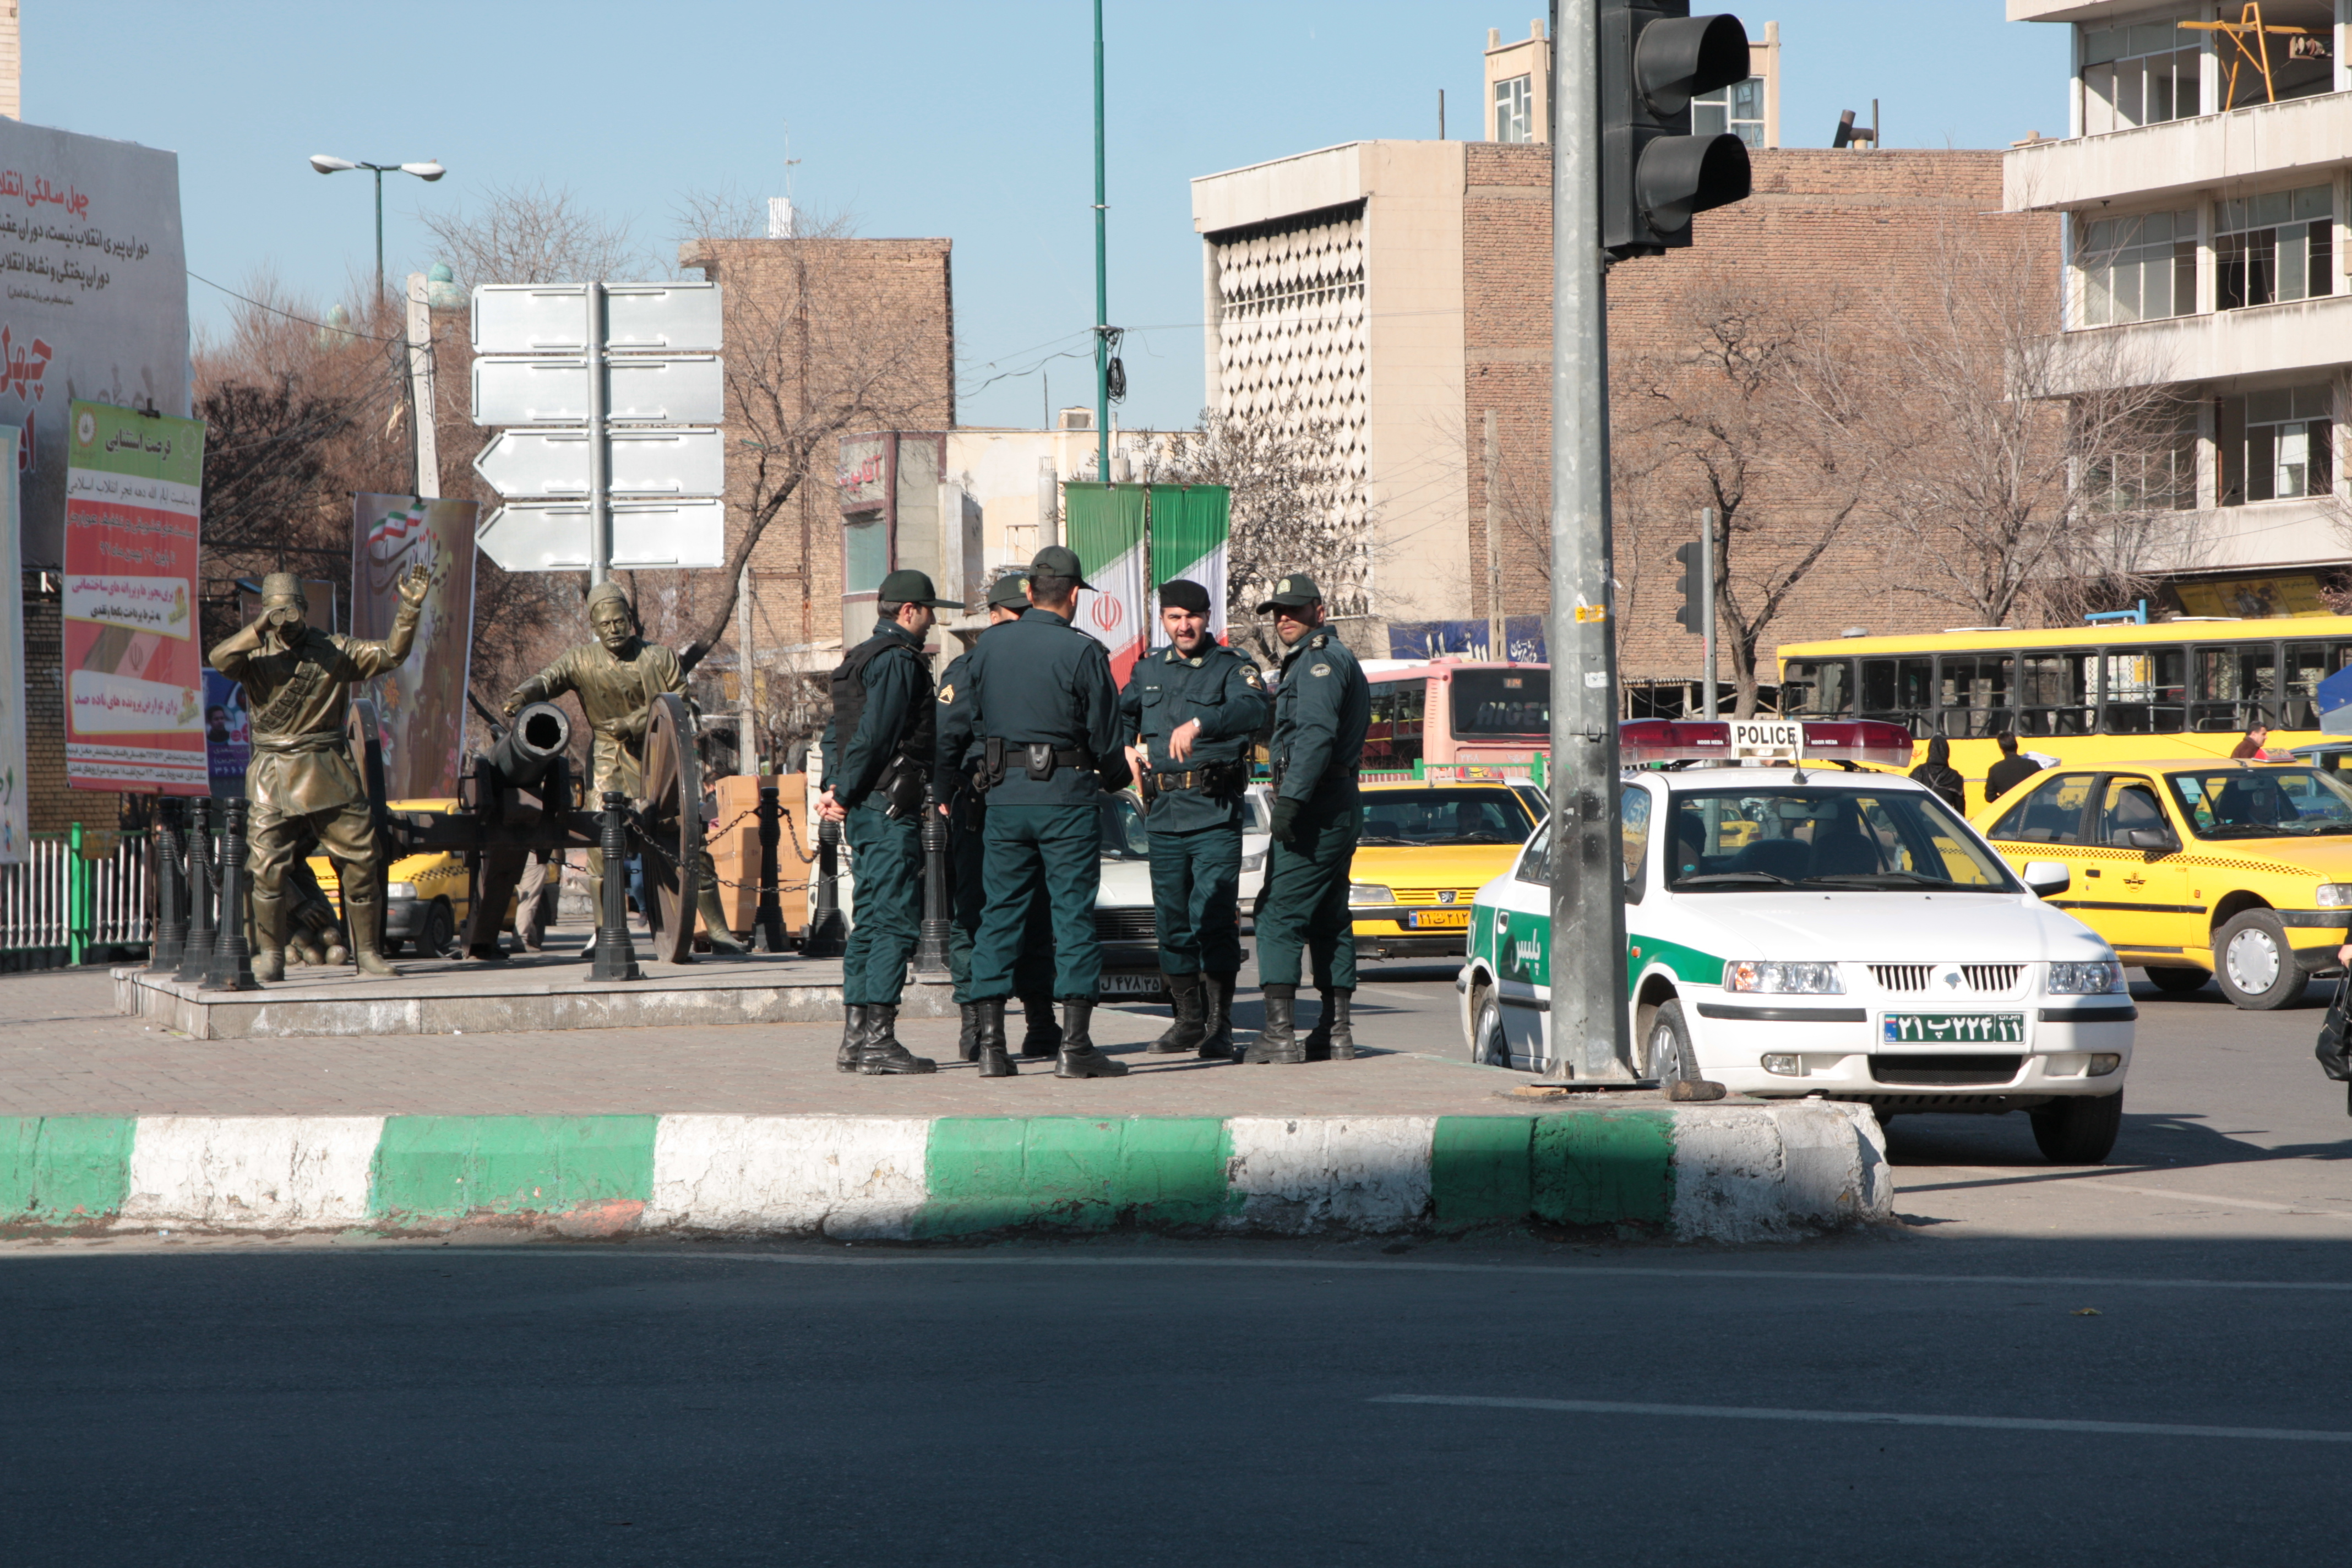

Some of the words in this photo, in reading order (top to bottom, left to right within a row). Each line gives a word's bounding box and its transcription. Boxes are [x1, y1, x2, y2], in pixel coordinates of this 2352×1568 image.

[0, 170, 23, 197] انقلا
[25, 174, 64, 207] سالگی
[66, 184, 89, 221] چهل
[18, 217, 43, 243] دوران
[75, 227, 103, 249] انقلاب
[104, 237, 126, 262] پیری
[126, 235, 149, 260] دوران
[26, 253, 49, 275] نشاط
[50, 266, 55, 282] و
[57, 259, 85, 291] پختگی
[86, 265, 110, 291] دوران
[106, 428, 143, 453] استثنایی
[145, 435, 171, 460] فرصت
[67, 476, 94, 494] اسلامی
[96, 479, 118, 494] انقلاب
[119, 483, 132, 499] فجر
[134, 488, 145, 498] دهه
[170, 490, 190, 505] مناسبت
[66, 510, 97, 528] عوارض
[72, 577, 108, 593] ساختمانی
[74, 694, 90, 705] صد
[1737, 726, 1796, 744] POLICE
[1510, 928, 1540, 976] پلیس
[1115, 976, 1141, 990] ۴۷۸
[1898, 1017, 1924, 1039] ۲۱
[1928, 1019, 1951, 1039] پ
[1953, 1017, 1992, 1040] ۲۲۴
[1999, 1021, 2021, 1041] ۱۱
